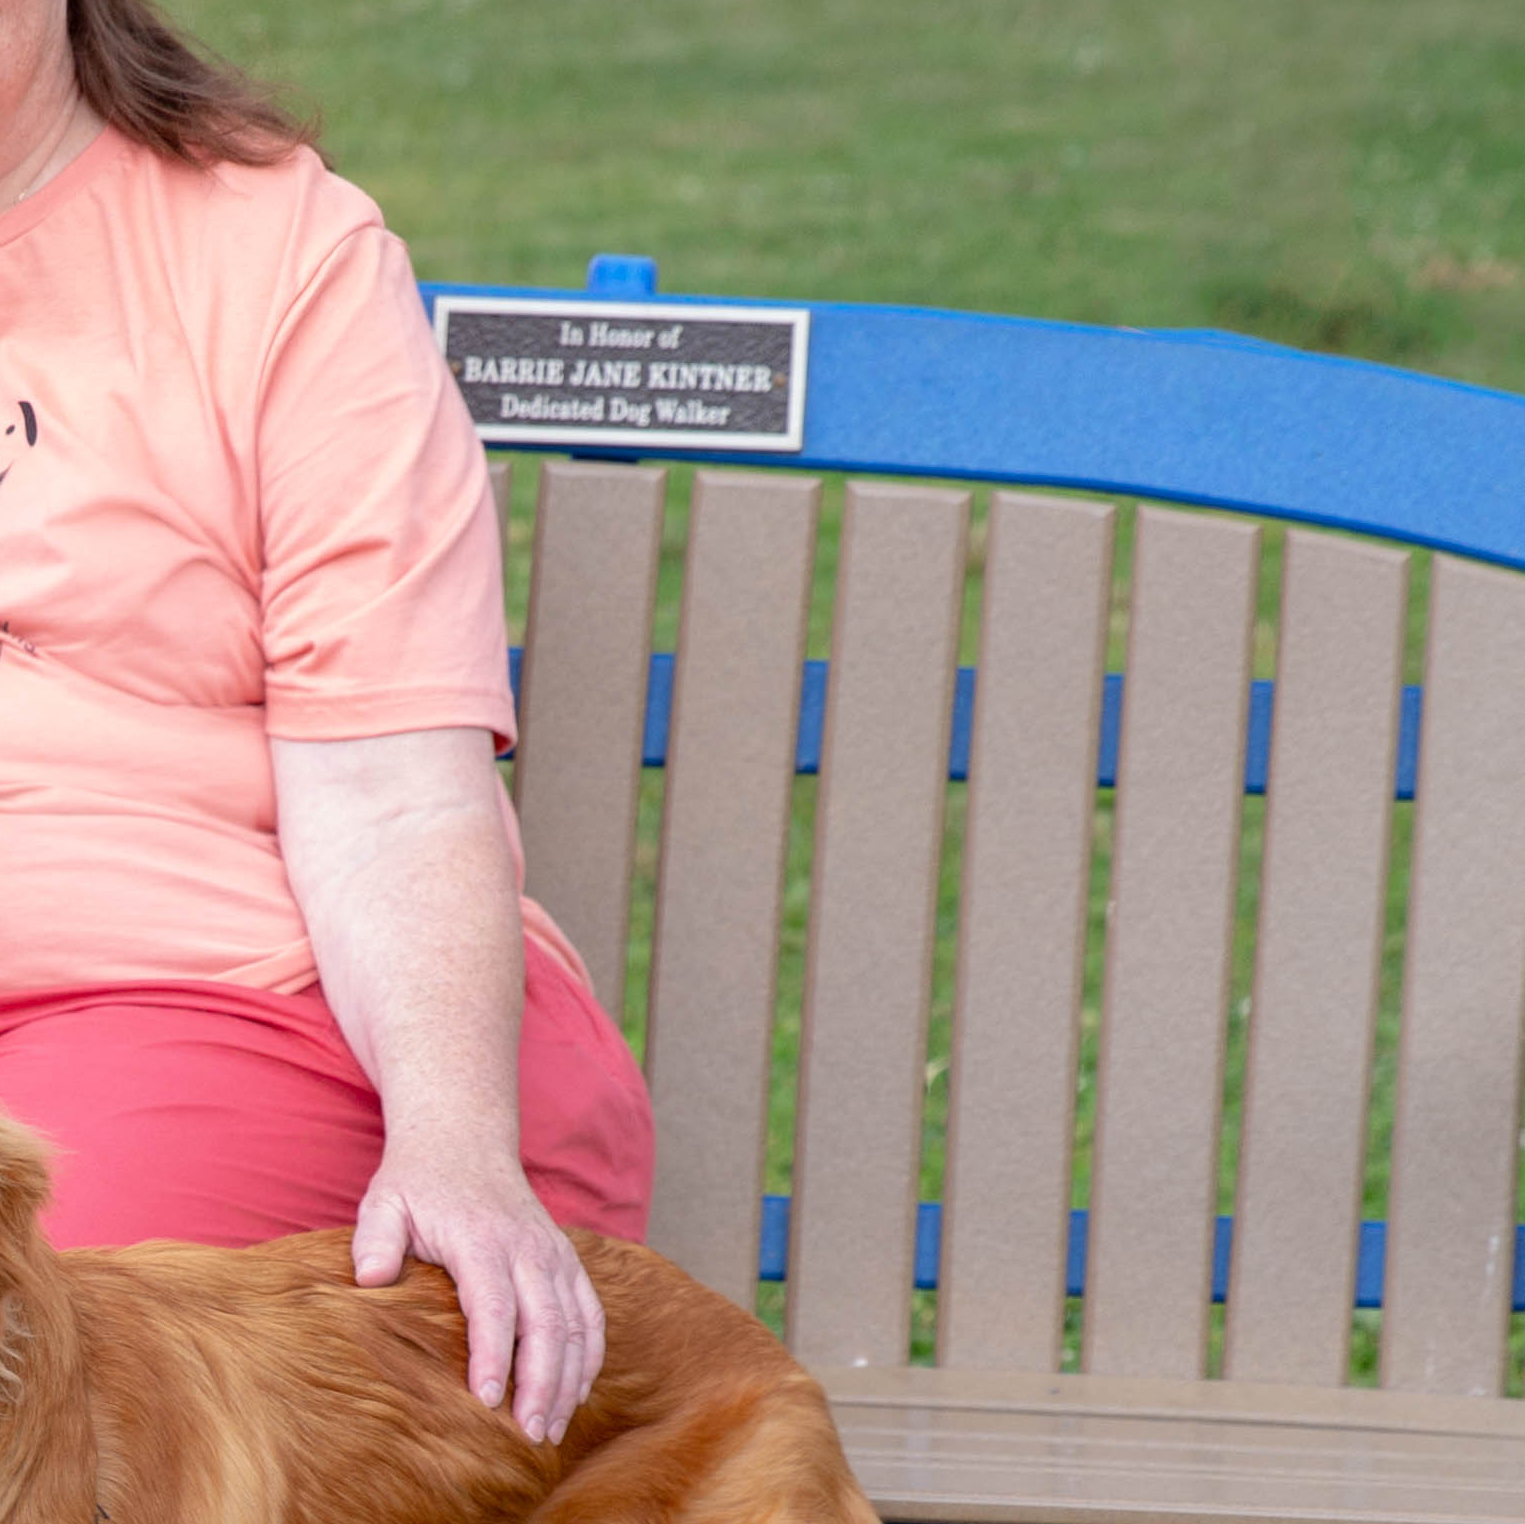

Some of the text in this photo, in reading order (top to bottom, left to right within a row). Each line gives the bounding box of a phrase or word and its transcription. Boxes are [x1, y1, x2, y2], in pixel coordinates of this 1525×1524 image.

[560, 320, 684, 350] In Honor of
[464, 355, 773, 393] BARRIE JANE KINTNER
[500, 393, 732, 427] Dedicated Dog Walker
